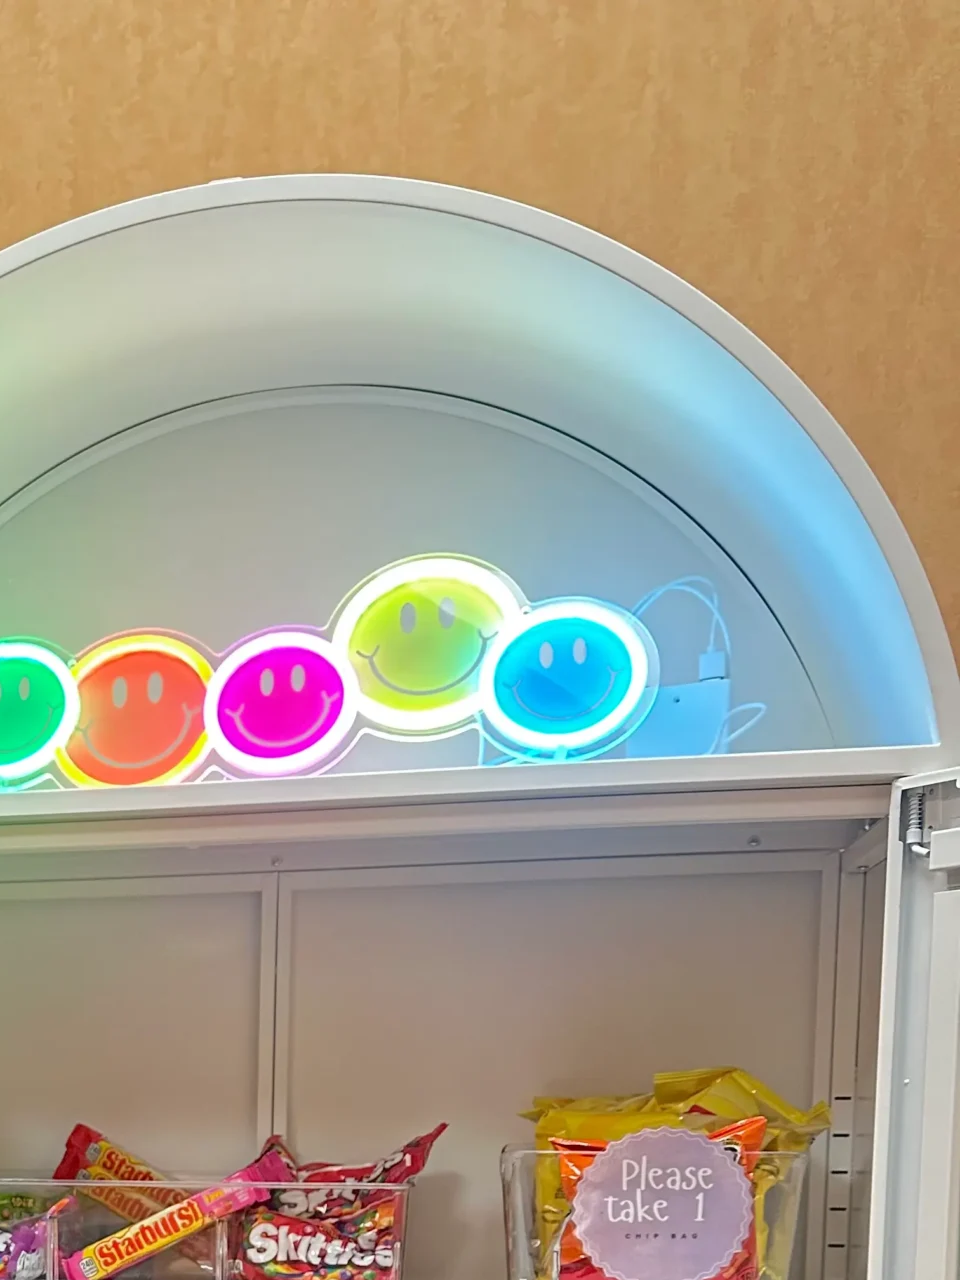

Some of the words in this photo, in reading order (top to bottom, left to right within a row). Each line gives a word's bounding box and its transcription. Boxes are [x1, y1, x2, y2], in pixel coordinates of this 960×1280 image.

[622, 1155, 714, 1191] Please
[604, 1188, 670, 1223] take
[693, 1191, 705, 1222] 1
[96, 1200, 200, 1267] Starburst
